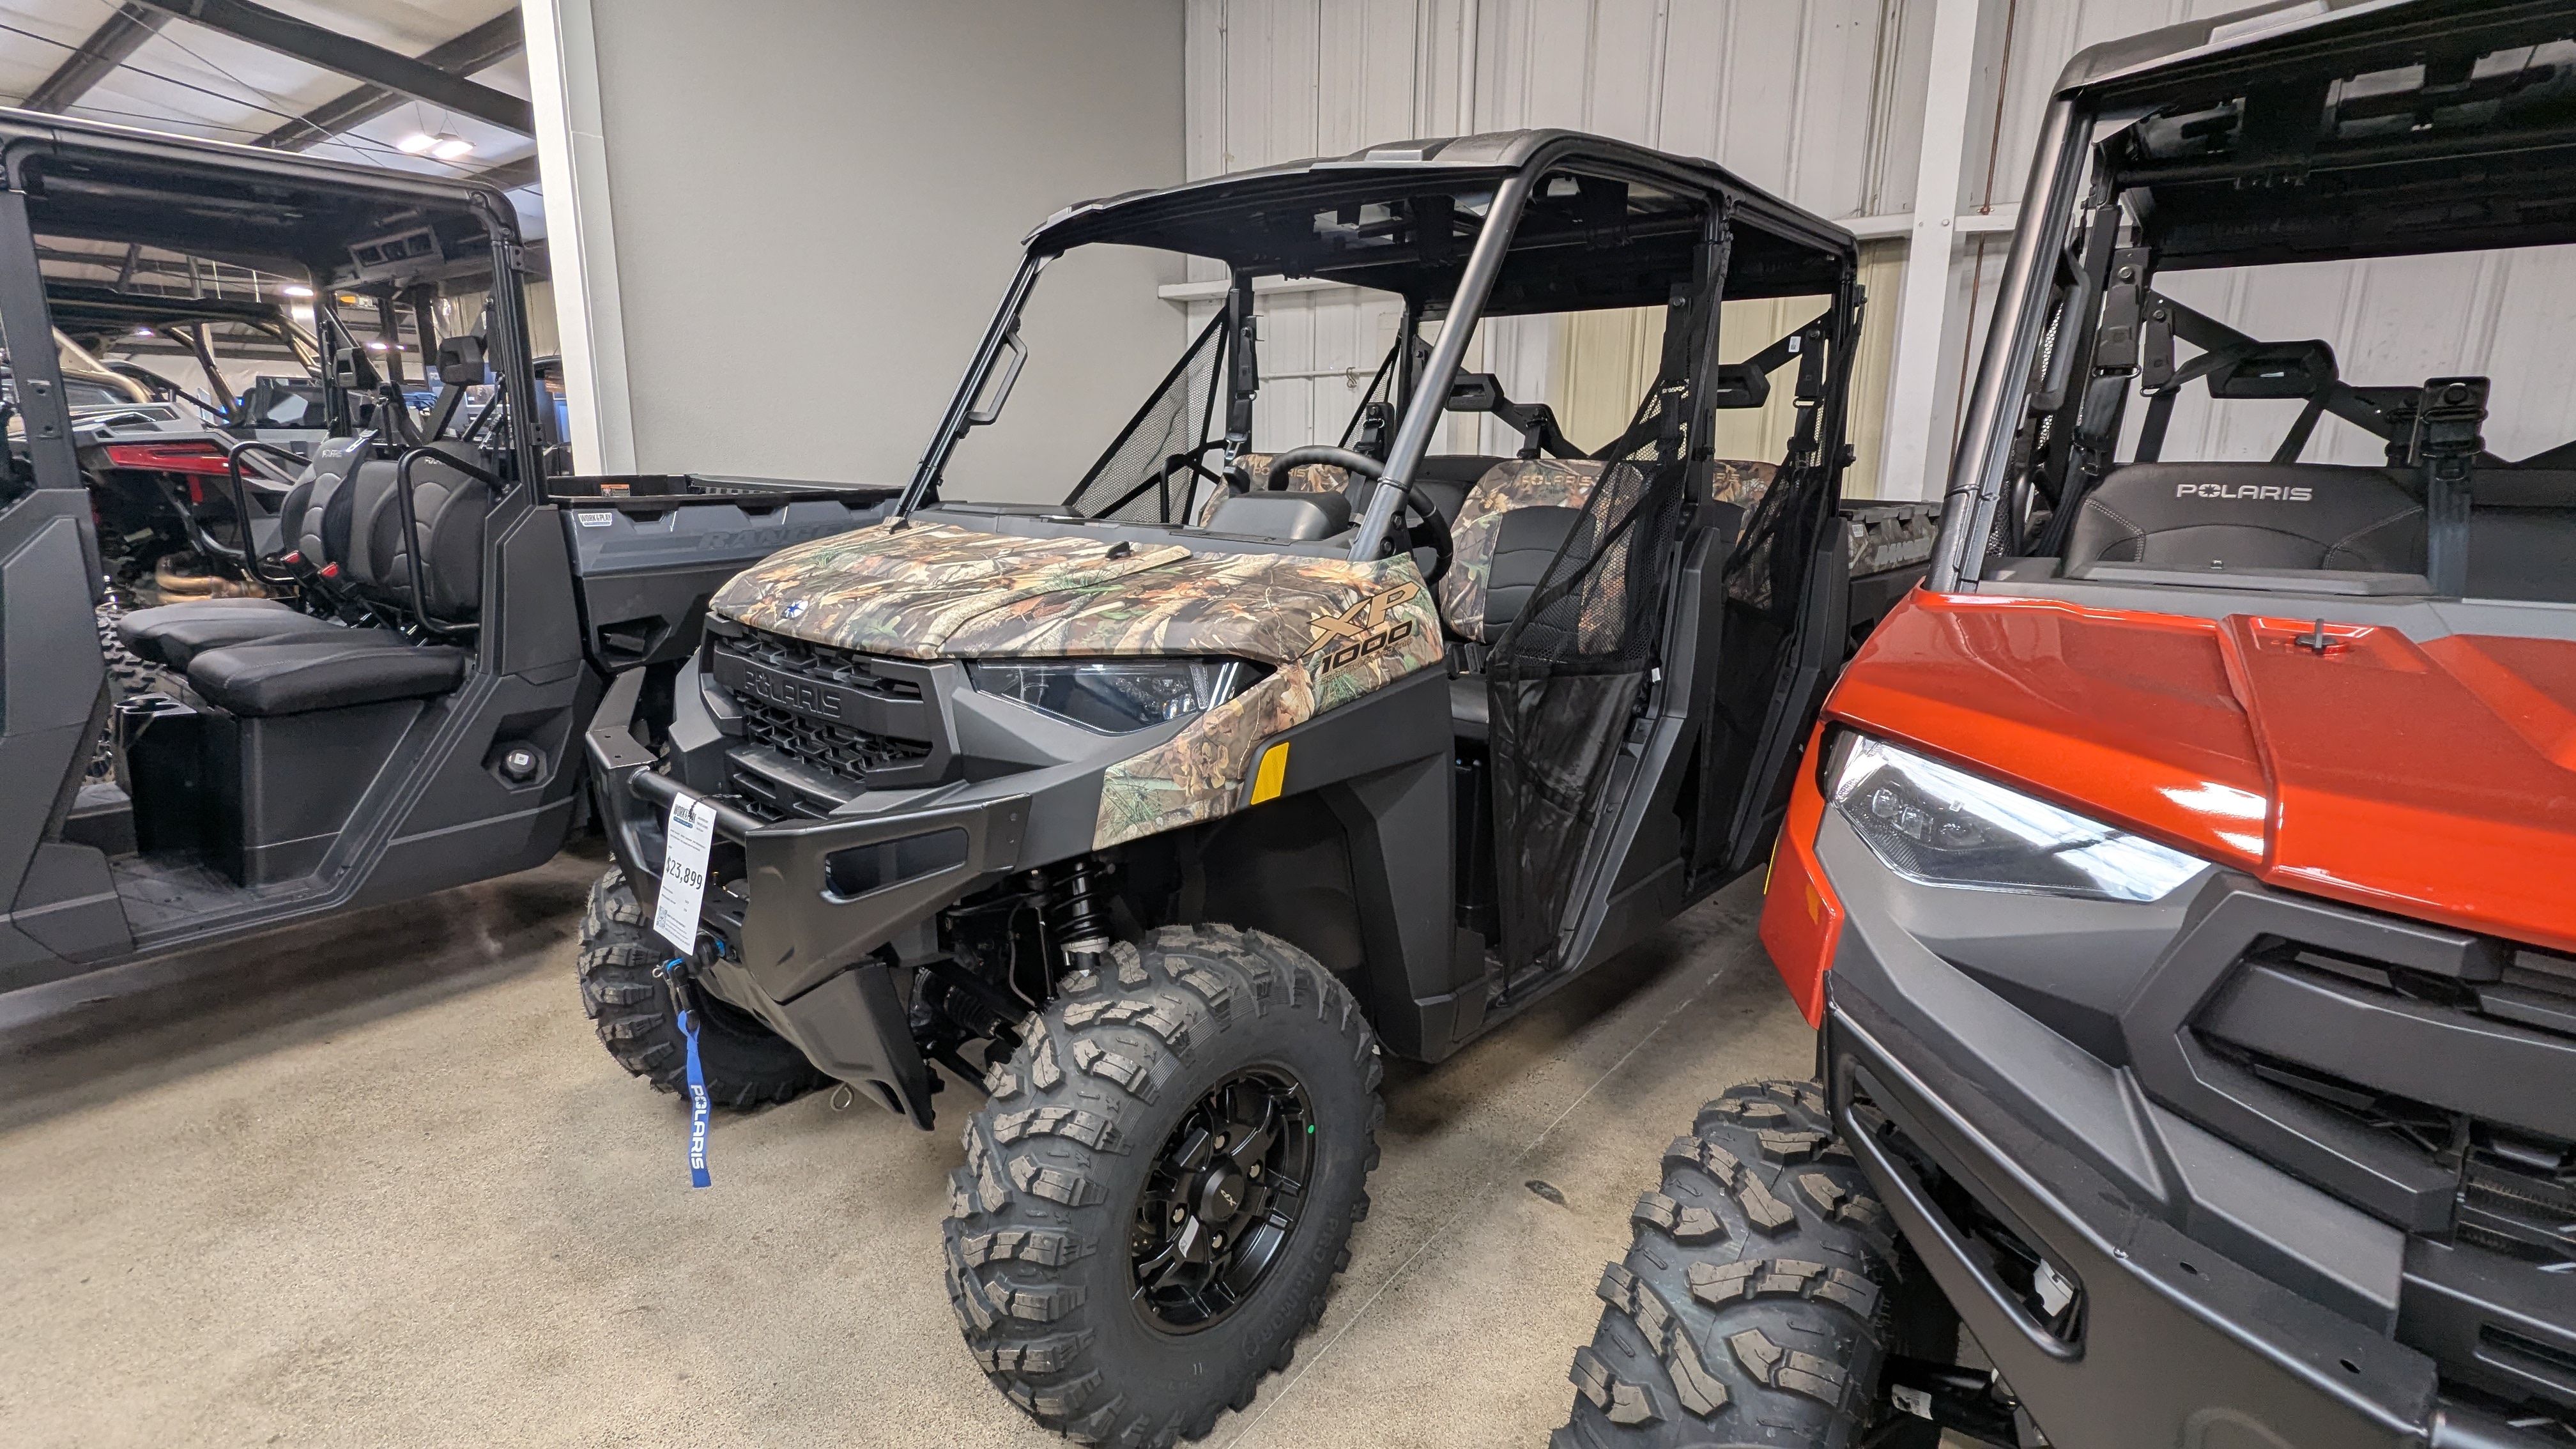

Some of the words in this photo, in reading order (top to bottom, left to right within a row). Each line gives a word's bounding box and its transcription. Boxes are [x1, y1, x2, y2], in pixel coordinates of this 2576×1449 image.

[1522, 475, 1592, 486] POLARIS
[2177, 484, 2312, 501] POLARIS
[1297, 581, 1421, 660] XP
[1322, 620, 1413, 675] 1000
[744, 667, 841, 718] POLARIS
[666, 855, 703, 890] $23,899
[690, 1084, 707, 1170] POLARIS
